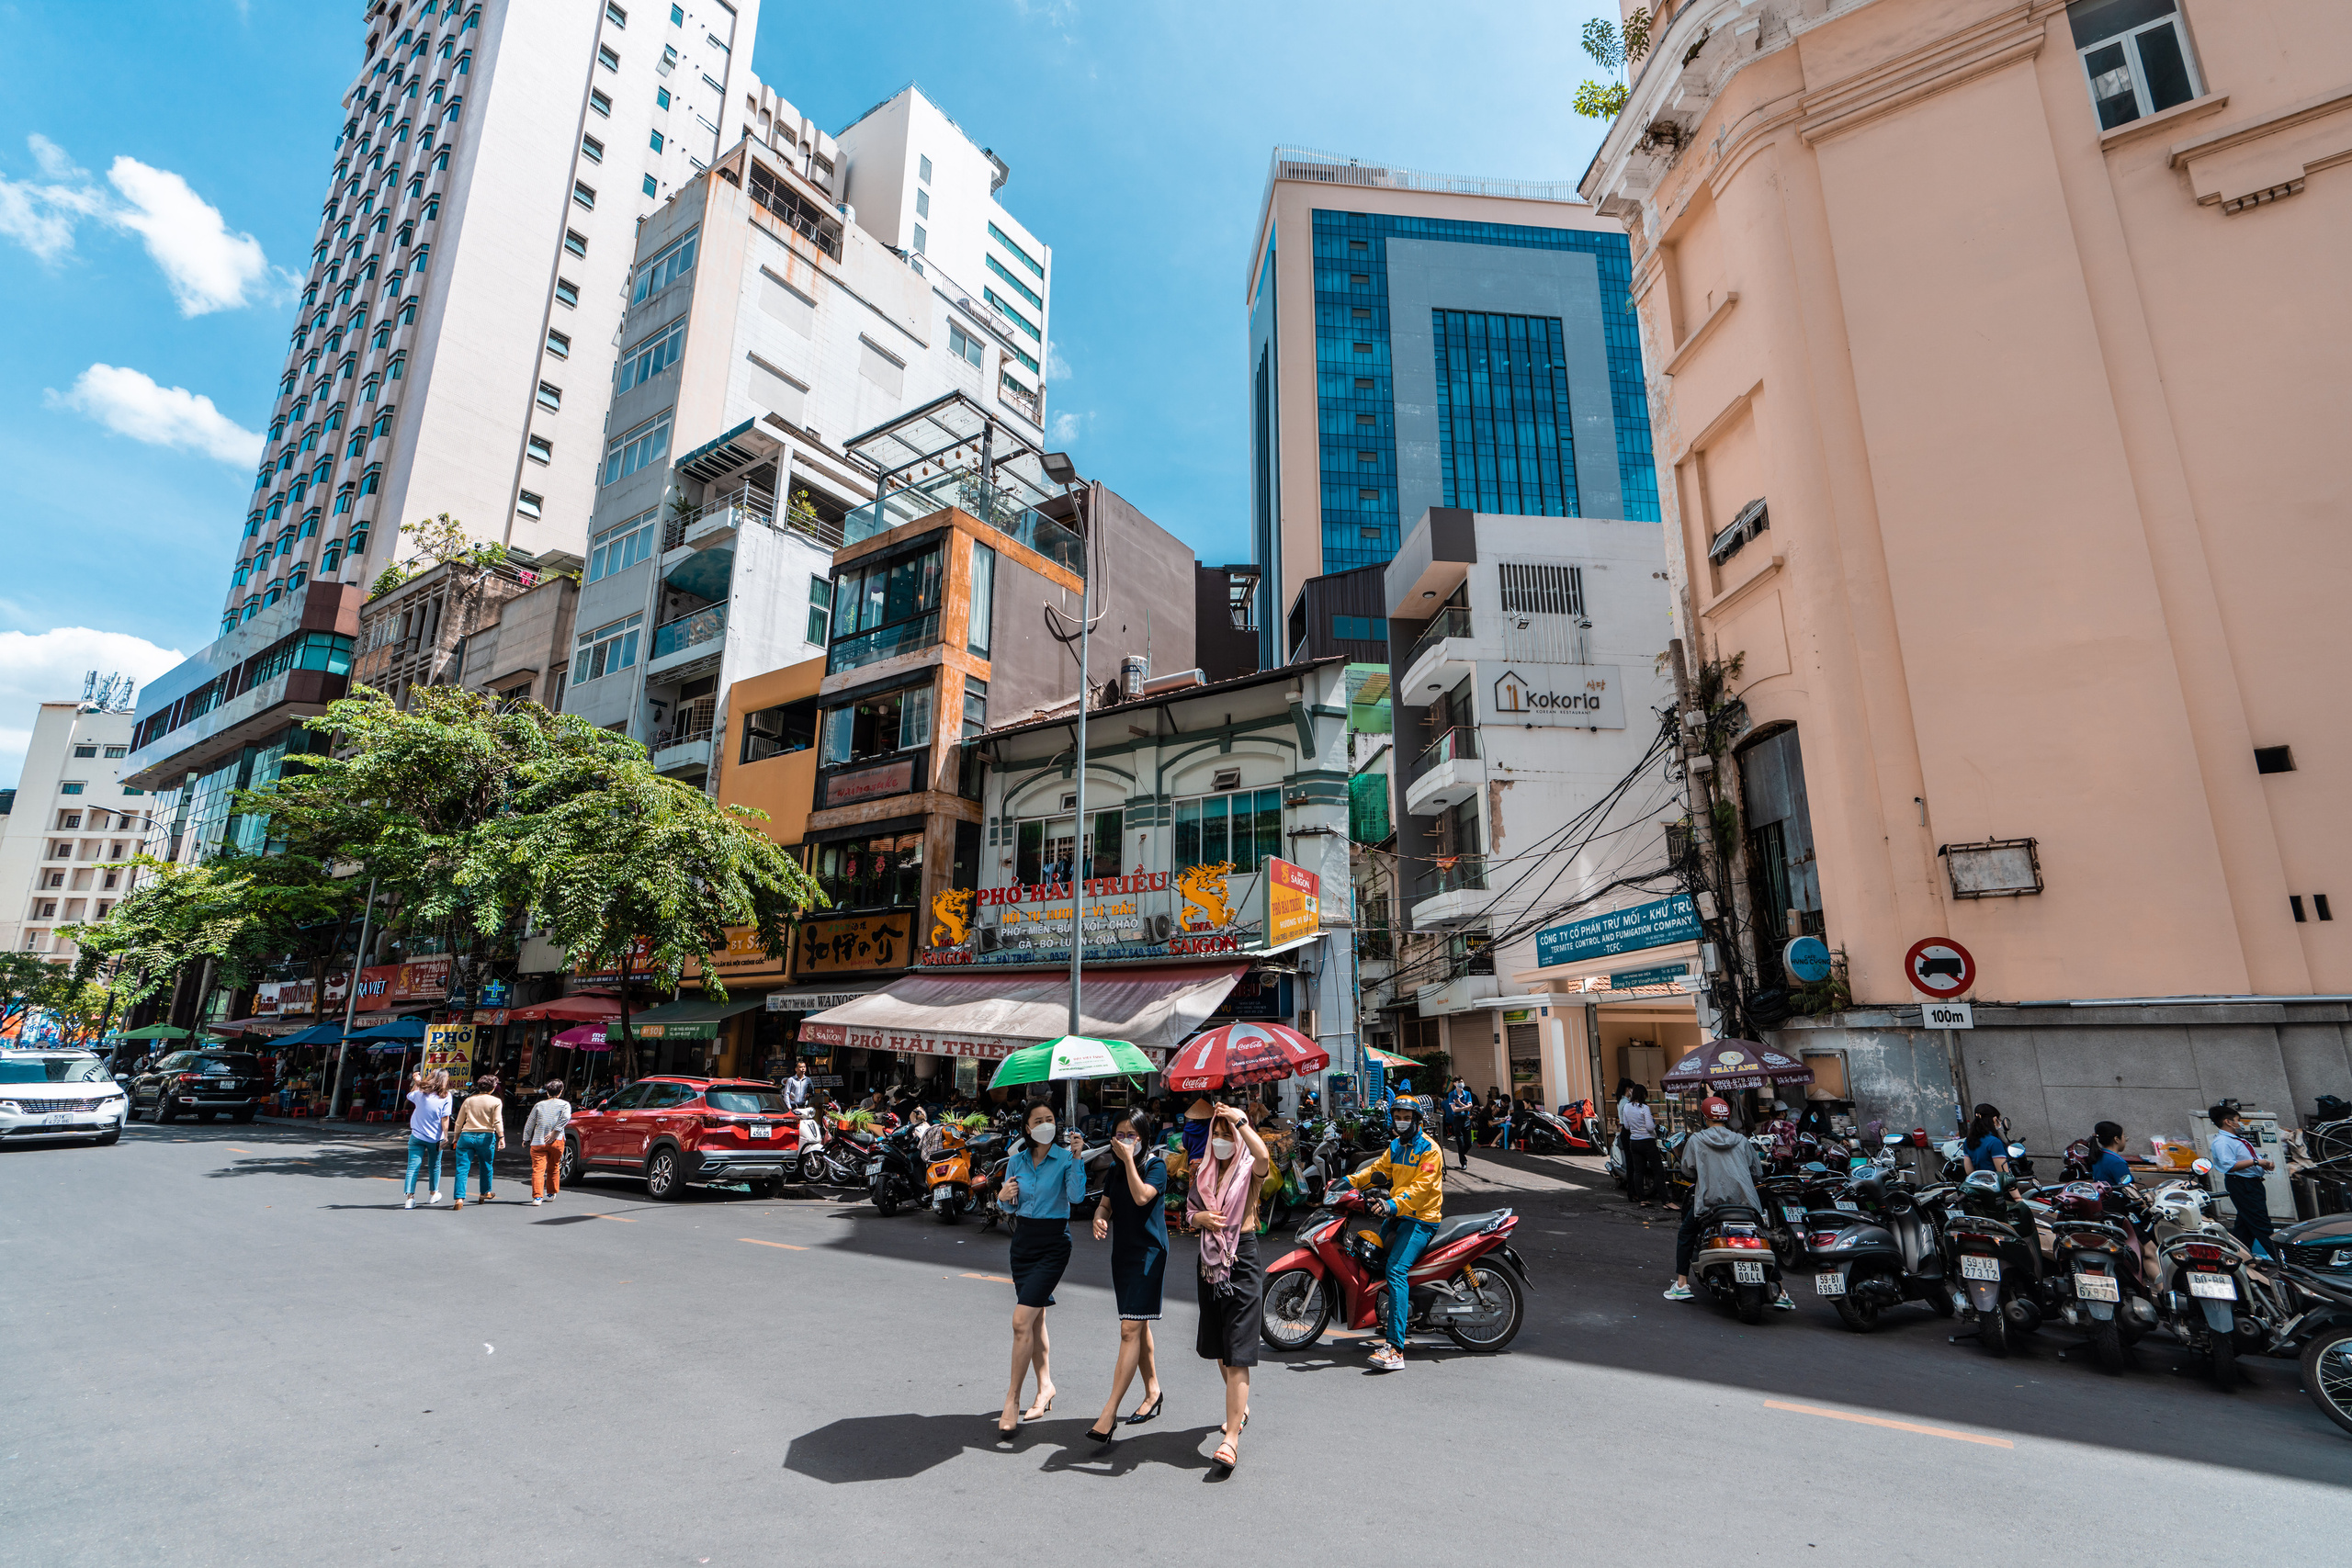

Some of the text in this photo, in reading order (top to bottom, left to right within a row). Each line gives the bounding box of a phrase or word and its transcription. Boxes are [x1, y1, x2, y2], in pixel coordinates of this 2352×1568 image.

[976, 863, 1169, 907] PHỞ HẢI TRIỀU
[1002, 899, 1136, 927] HỘI TỤ HƯƠG VỊ BẮC
[1001, 925, 1020, 937] PHỞ
[1083, 919, 1100, 931] XÔI
[1109, 919, 1138, 930] CHÁO
[1192, 921, 1213, 932] BIA
[1541, 932, 1557, 946] CÔNG
[1559, 931, 1568, 942] TY
[1569, 924, 1580, 940] CỔ
[1581, 920, 1601, 936] PHẦN
[1623, 908, 1641, 927] MỐI
[1649, 901, 1669, 920] KHỬ
[1551, 942, 1574, 953] TERMITE
[1575, 937, 1600, 949] CONTROL
[1601, 932, 1615, 943] AND
[1615, 926, 1652, 942] FUMIGATION
[1653, 915, 1693, 932] COMPANY
[939, 938, 955, 948] BIA
[1018, 938, 1032, 950] GÀ
[1040, 936, 1054, 948] BÒ
[1096, 936, 1117, 945] CUA
[1169, 935, 1238, 955] SAIGON
[922, 950, 973, 965] SAIGON
[982, 955, 990, 964] 31
[1107, 948, 1125, 958] 0767
[1129, 947, 1144, 957] 649
[1147, 946, 1162, 955] 999
[1931, 1010, 1964, 1023] 100m
[430, 1026, 473, 1043] PHỞ
[816, 1031, 842, 1041] SAIGON
[849, 1030, 884, 1049] PHỞ
[888, 1034, 936, 1055] HẢI
[427, 1049, 469, 1064] HÀ
[1710, 1065, 1736, 1074] PHÁT
[1737, 1063, 1758, 1071] ANH
[1737, 1262, 1759, 1272] 55-A6
[1966, 1258, 1993, 1269] 59-V3
[1738, 1272, 1761, 1281] 0044
[1820, 1275, 1839, 1284] 59-B1
[1964, 1267, 1997, 1280] 273.12
[1818, 1282, 1844, 1294] 696.34
